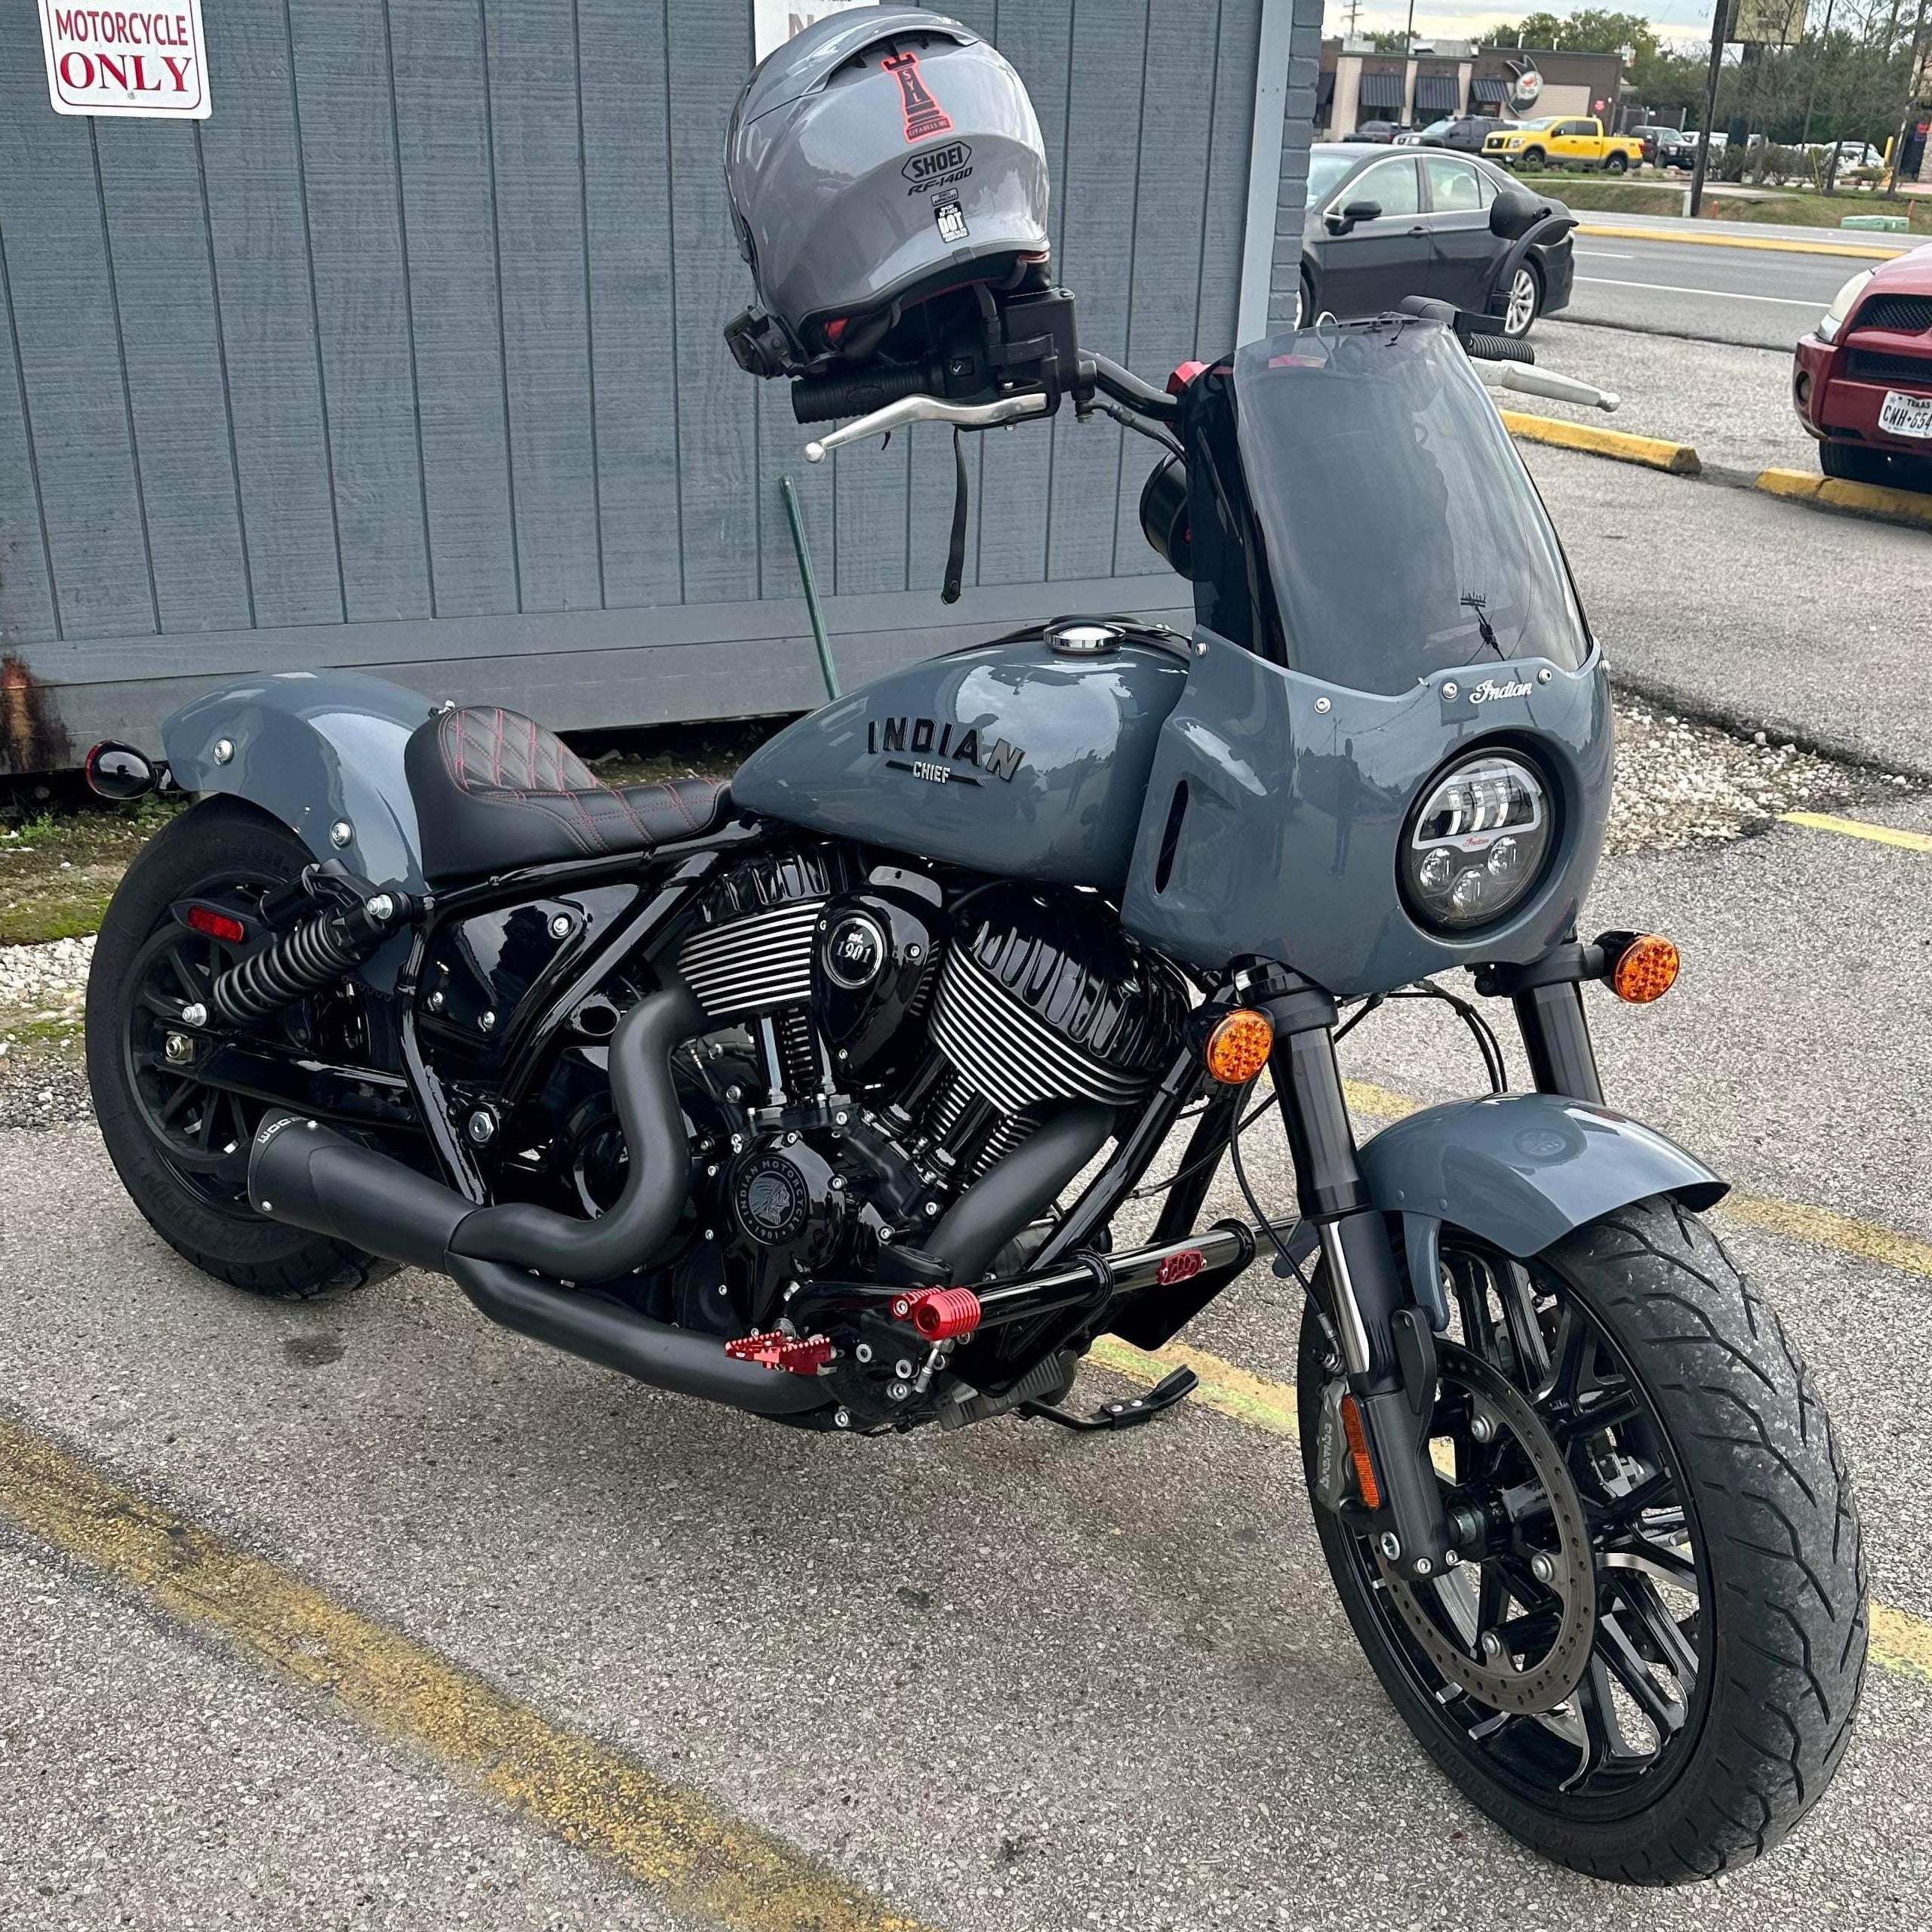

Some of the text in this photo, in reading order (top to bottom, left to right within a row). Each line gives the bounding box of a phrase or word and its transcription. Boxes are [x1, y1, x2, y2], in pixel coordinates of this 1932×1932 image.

[55, 9, 189, 46] MOTORCYCLE
[60, 52, 192, 91] ONLY
[912, 146, 964, 178] SHOEI
[907, 167, 973, 196] RF-1400
[937, 211, 964, 234] DOT
[1907, 398, 1930, 409] TEXAS
[1469, 679, 1533, 704] Indian
[868, 716, 1026, 783] INDIAN
[912, 761, 952, 784] CHIEF
[837, 941, 872, 963] 1901
[740, 1160, 804, 1232] INDIAN MOTORCYCLE
[755, 1224, 779, 1239] 1901
